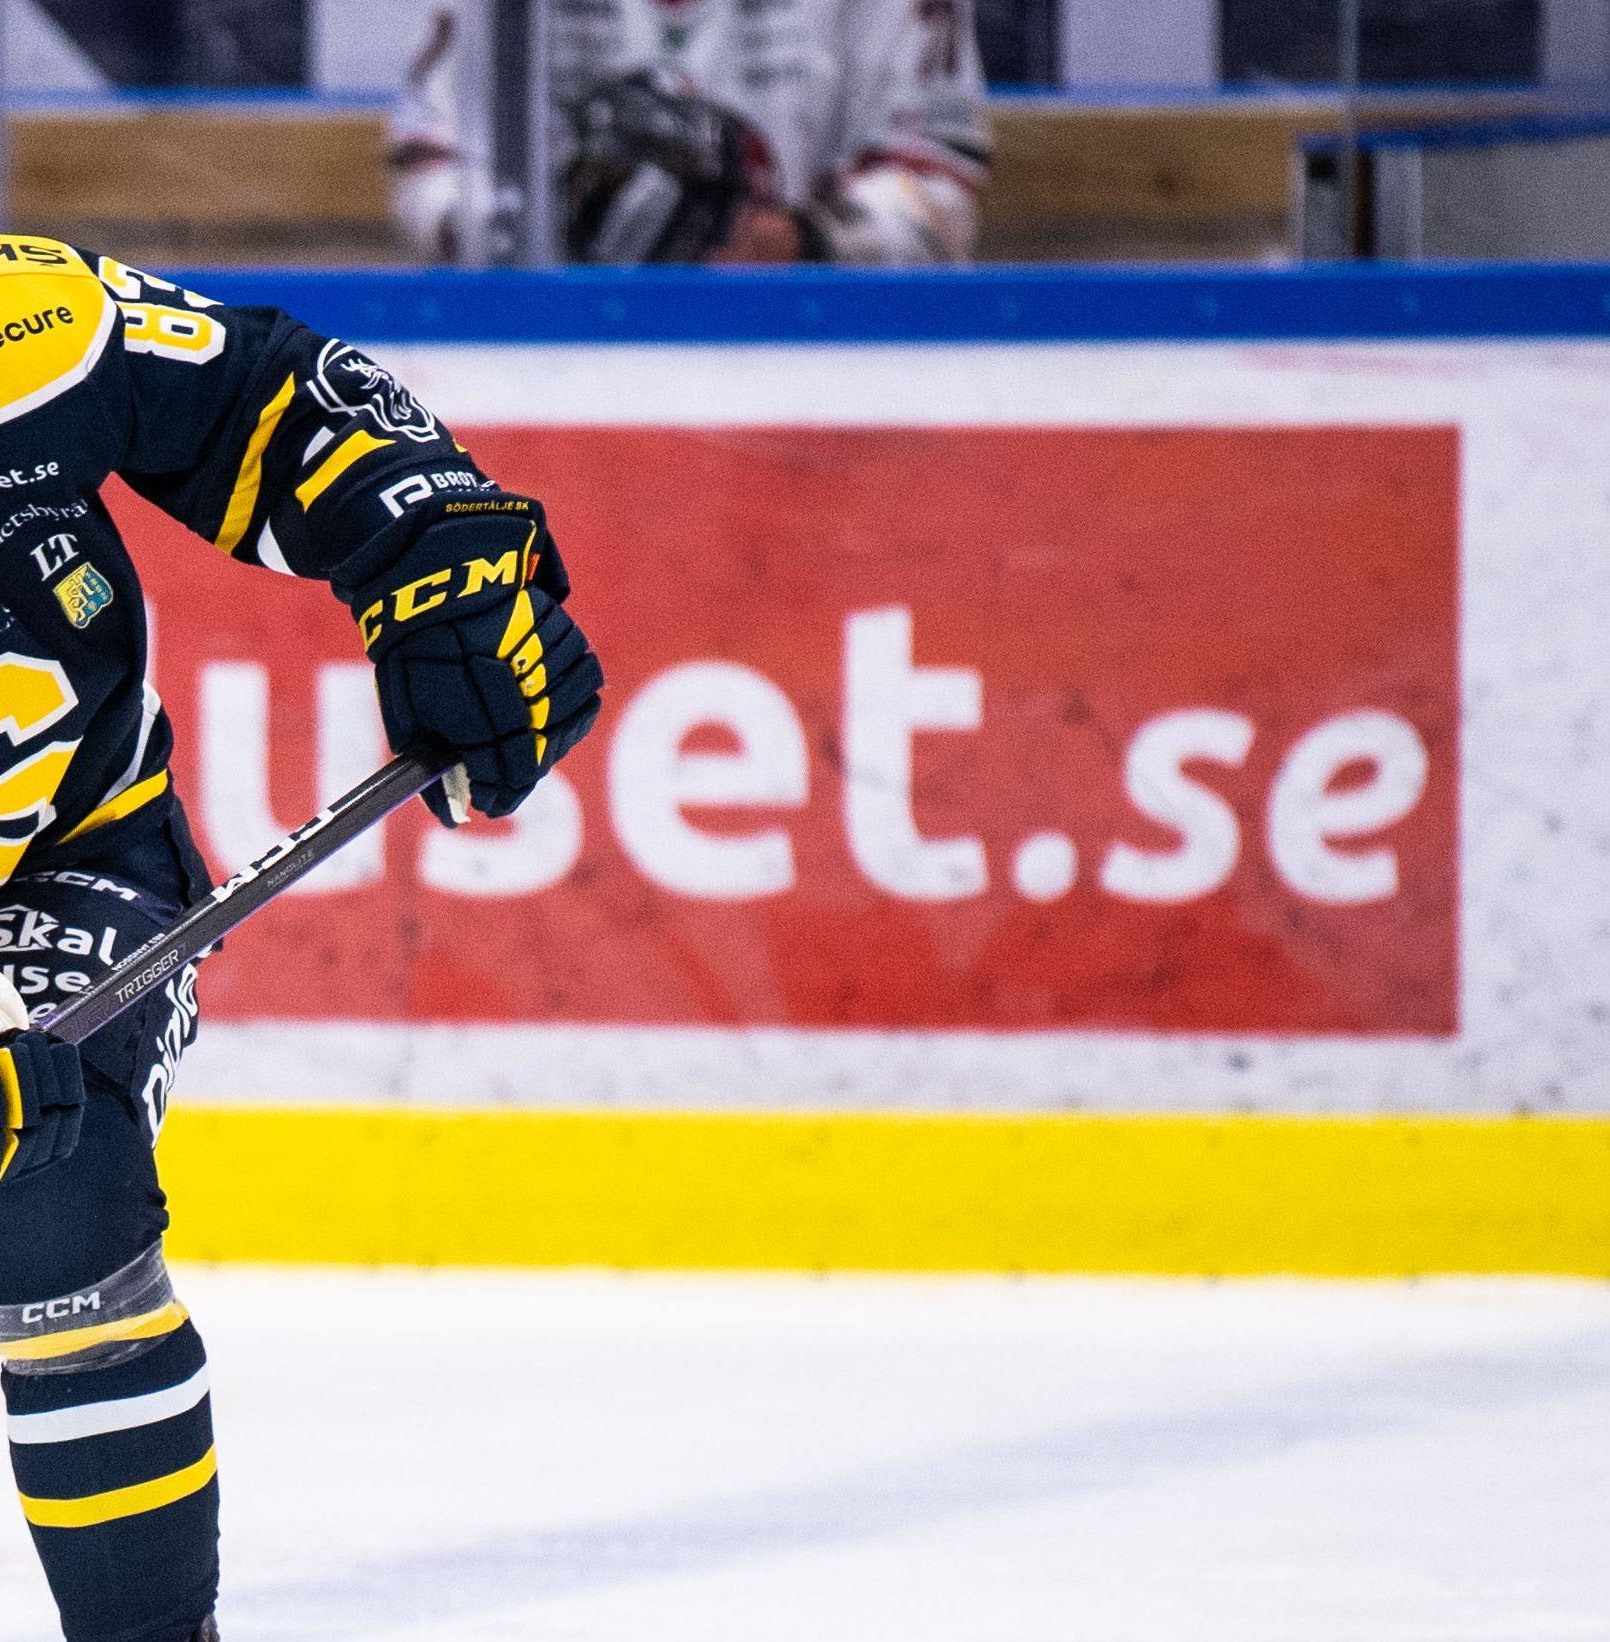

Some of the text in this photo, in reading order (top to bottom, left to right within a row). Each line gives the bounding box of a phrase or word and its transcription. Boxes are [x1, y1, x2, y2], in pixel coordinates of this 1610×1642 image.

[515, 501, 530, 512] SK
[30, 533, 79, 582] LT
[358, 550, 519, 654] CCM
[115, 950, 180, 1004] TRIGGER
[20, 1291, 101, 1324] CCM
